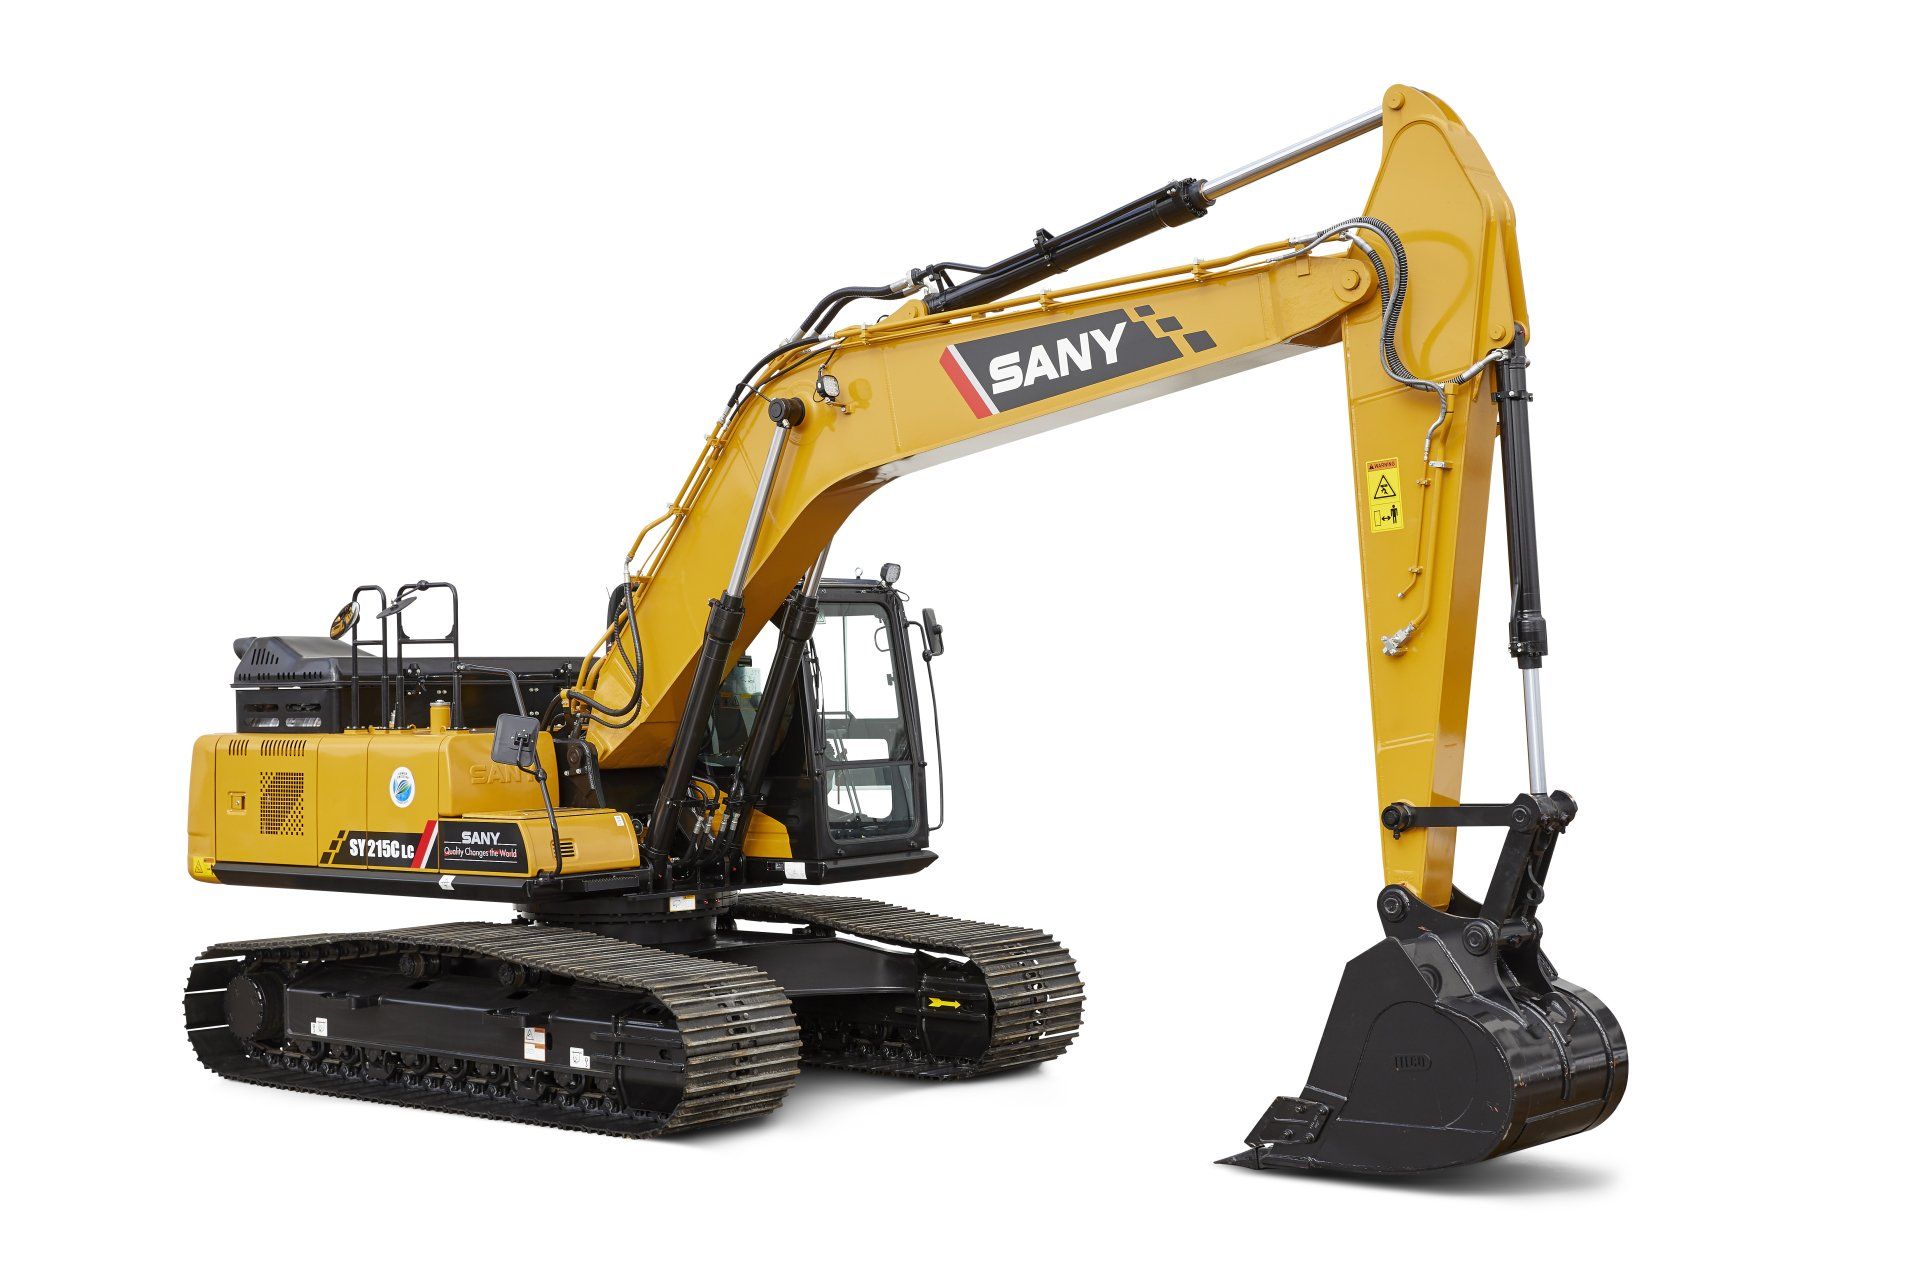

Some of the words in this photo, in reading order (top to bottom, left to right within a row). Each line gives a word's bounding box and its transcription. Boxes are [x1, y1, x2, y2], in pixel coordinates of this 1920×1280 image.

[989, 321, 1127, 395] SANY
[469, 763, 537, 785] SAN
[461, 831, 501, 846] SANY
[444, 846, 464, 858] Quality
[464, 847, 489, 859] Changes
[489, 847, 499, 857] the
[500, 849, 517, 858] World
